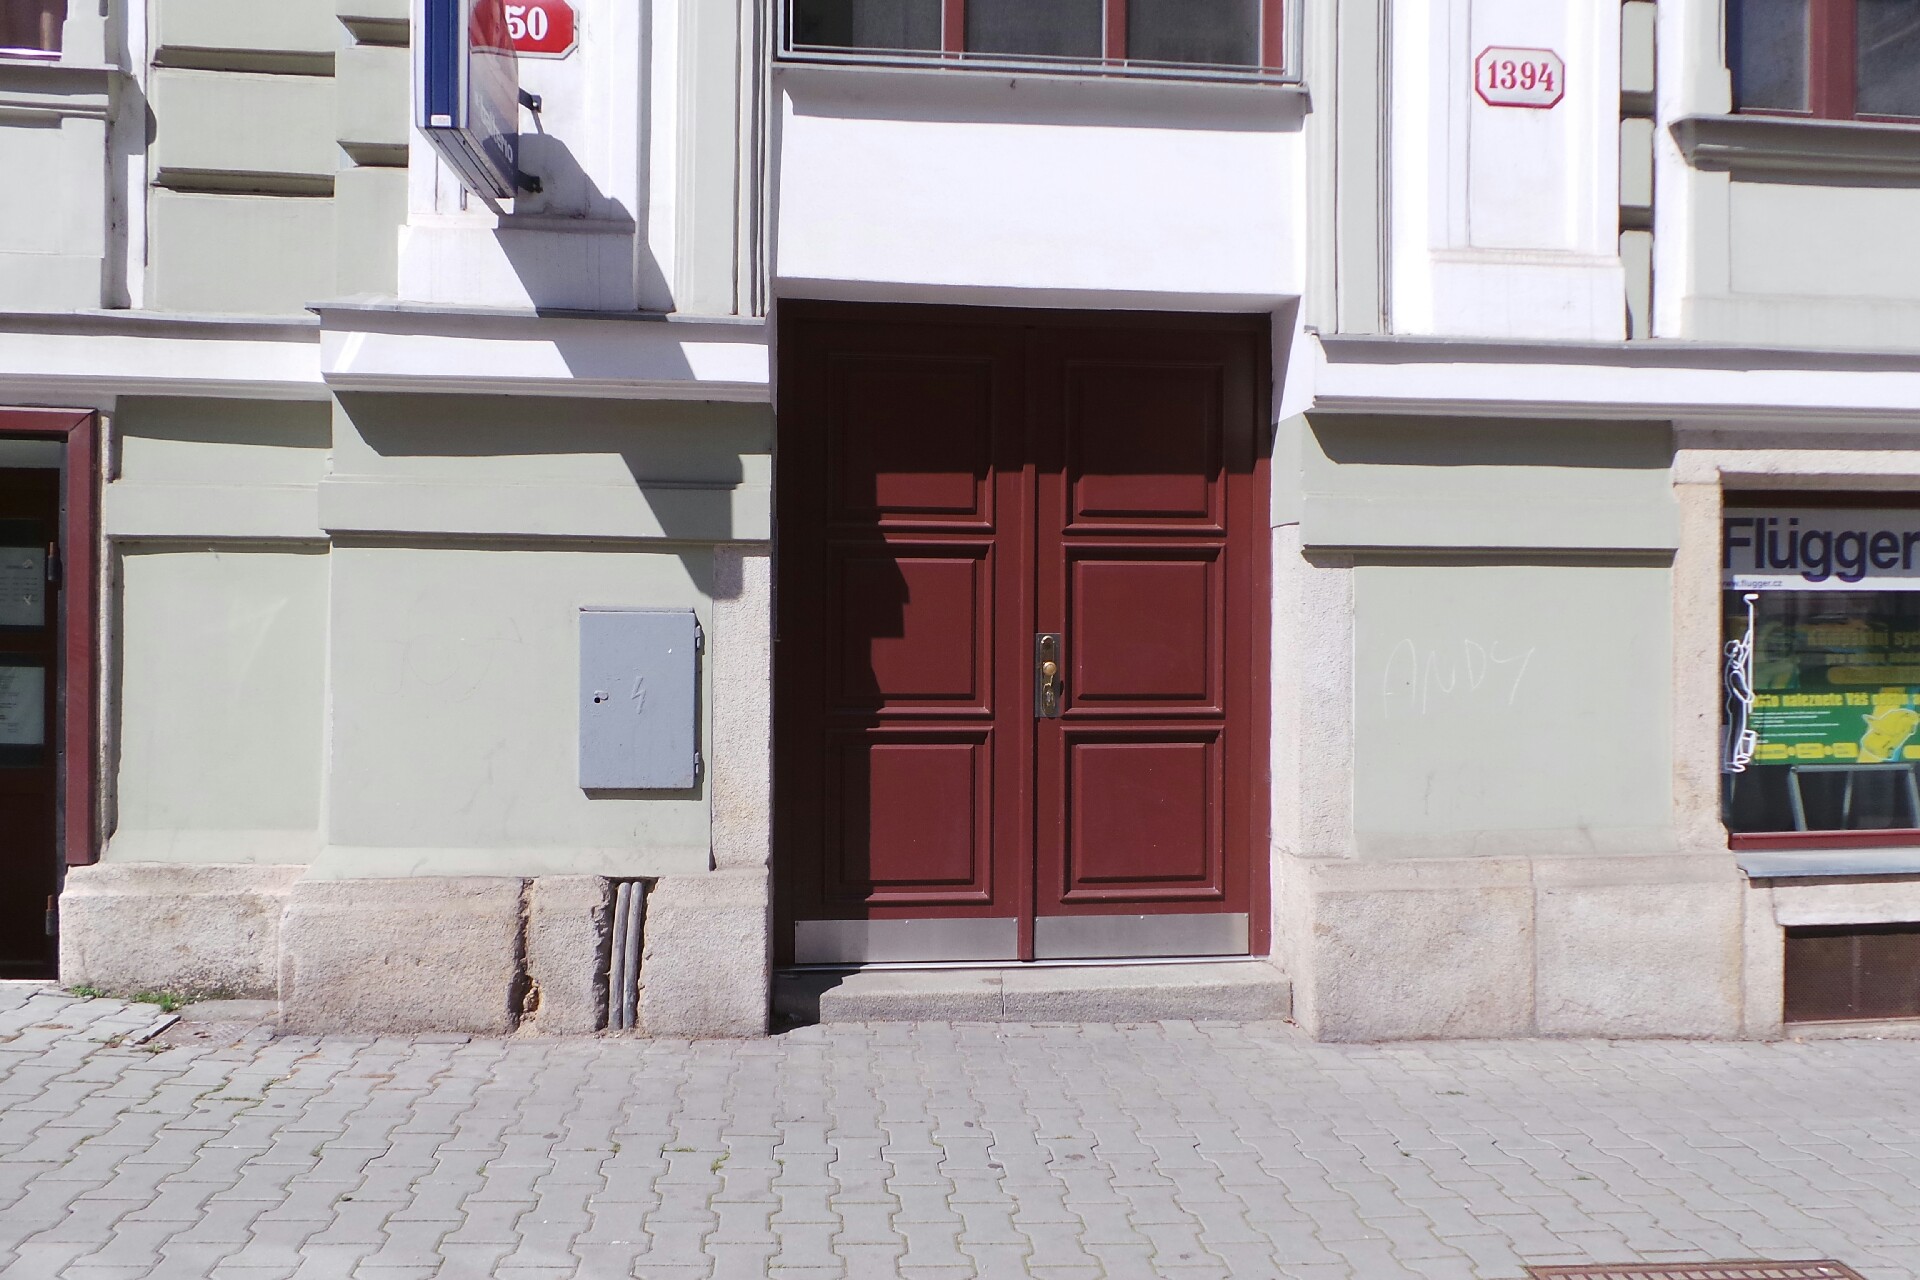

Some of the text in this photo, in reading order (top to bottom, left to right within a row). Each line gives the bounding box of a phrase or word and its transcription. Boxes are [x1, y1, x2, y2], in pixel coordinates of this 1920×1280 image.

[505, 5, 549, 41] 50
[1488, 60, 1554, 92] 1394
[1723, 517, 1920, 583] Flügger
